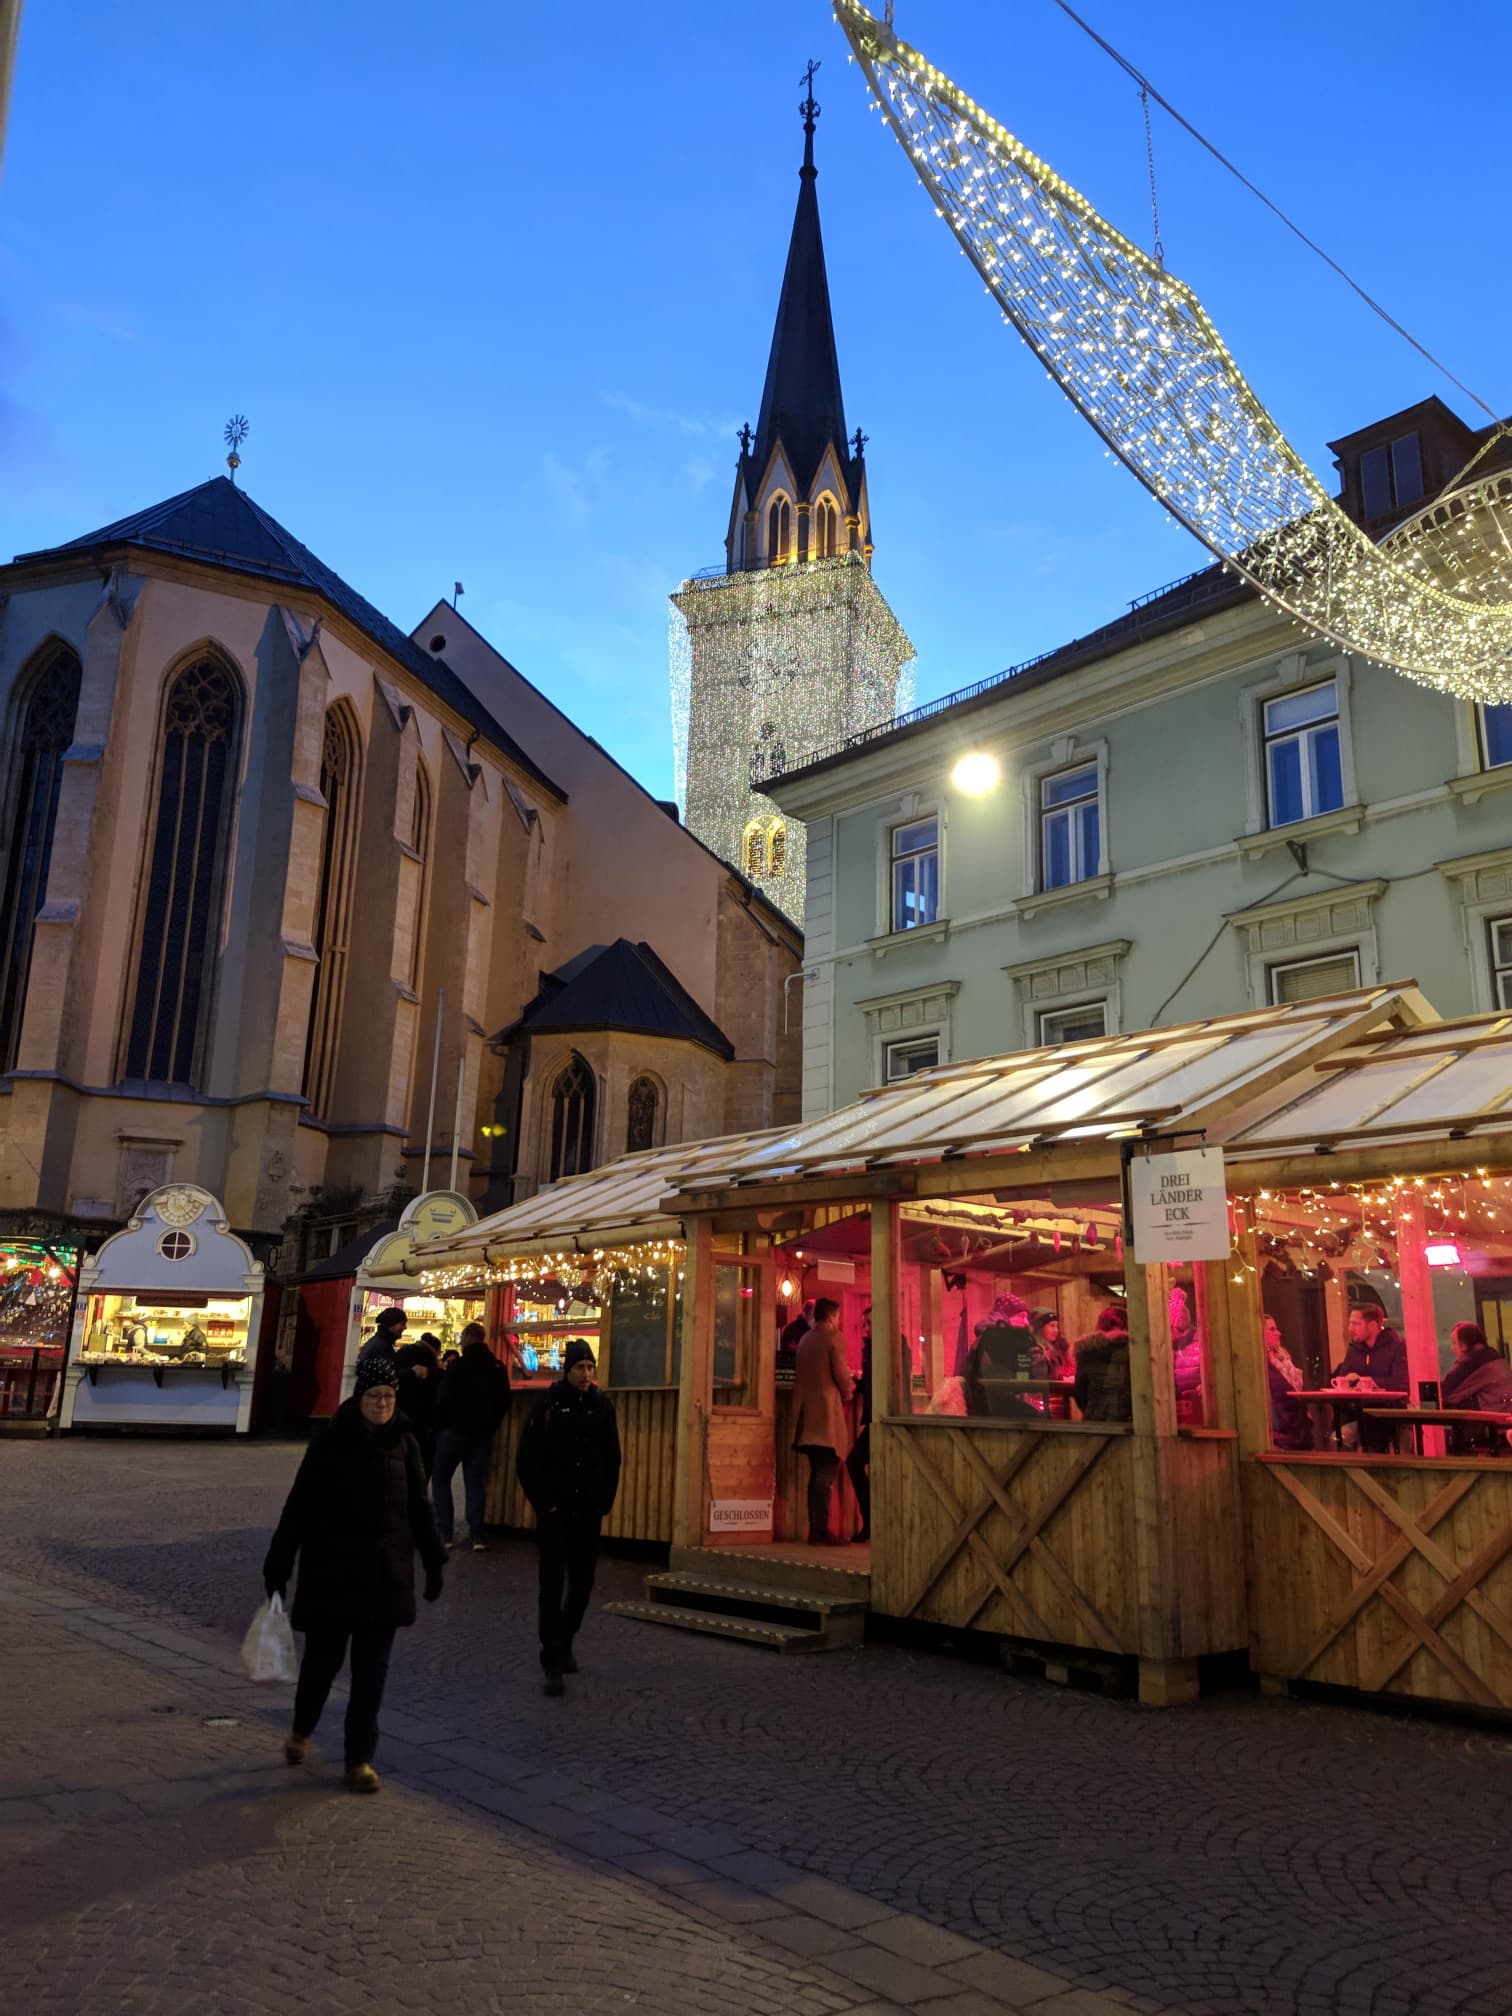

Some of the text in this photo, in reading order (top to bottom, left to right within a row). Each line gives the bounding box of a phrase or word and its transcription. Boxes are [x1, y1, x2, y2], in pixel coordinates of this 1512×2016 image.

[1160, 1173, 1191, 1188] DREI
[1150, 1188, 1203, 1206] LÄNDER
[1165, 1206, 1190, 1221] ECK
[713, 1510, 769, 1521] GESCHLOSSEN
